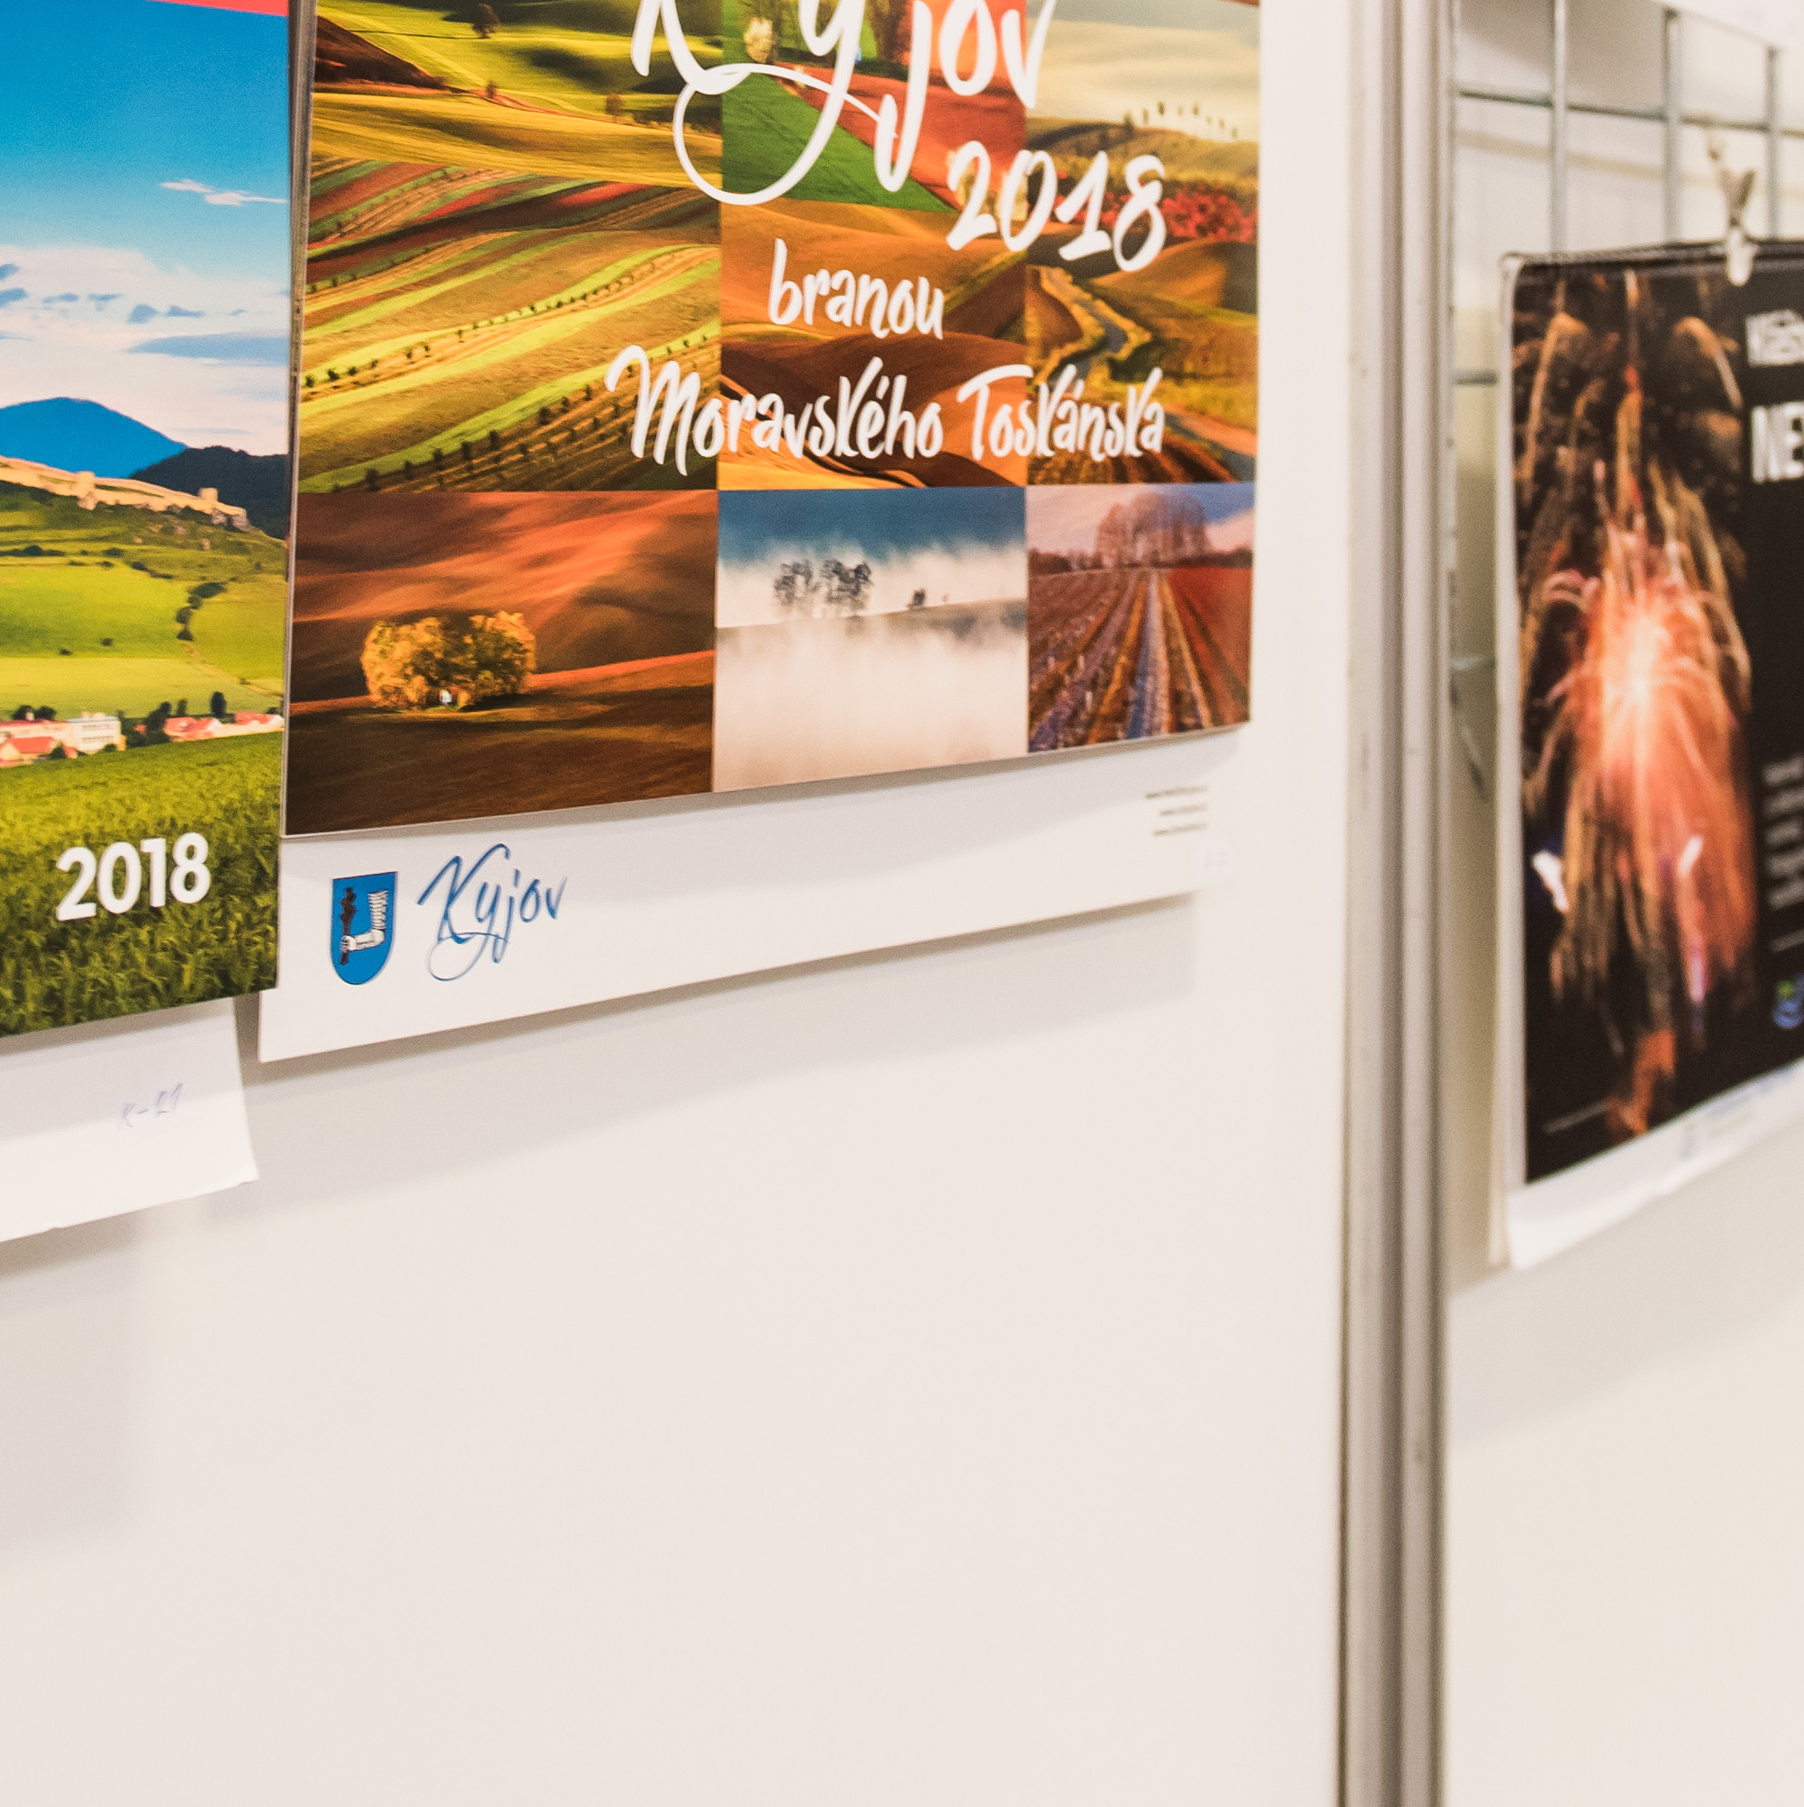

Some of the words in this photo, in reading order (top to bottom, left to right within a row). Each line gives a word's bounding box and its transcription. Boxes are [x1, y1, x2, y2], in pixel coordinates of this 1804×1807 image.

[946, 141, 1167, 273] 2018
[767, 238, 944, 340] branou
[605, 345, 943, 476] Moravského
[957, 364, 1165, 463] Toskánska
[56, 832, 211, 921] 2018
[417, 843, 568, 981] Kyjov
